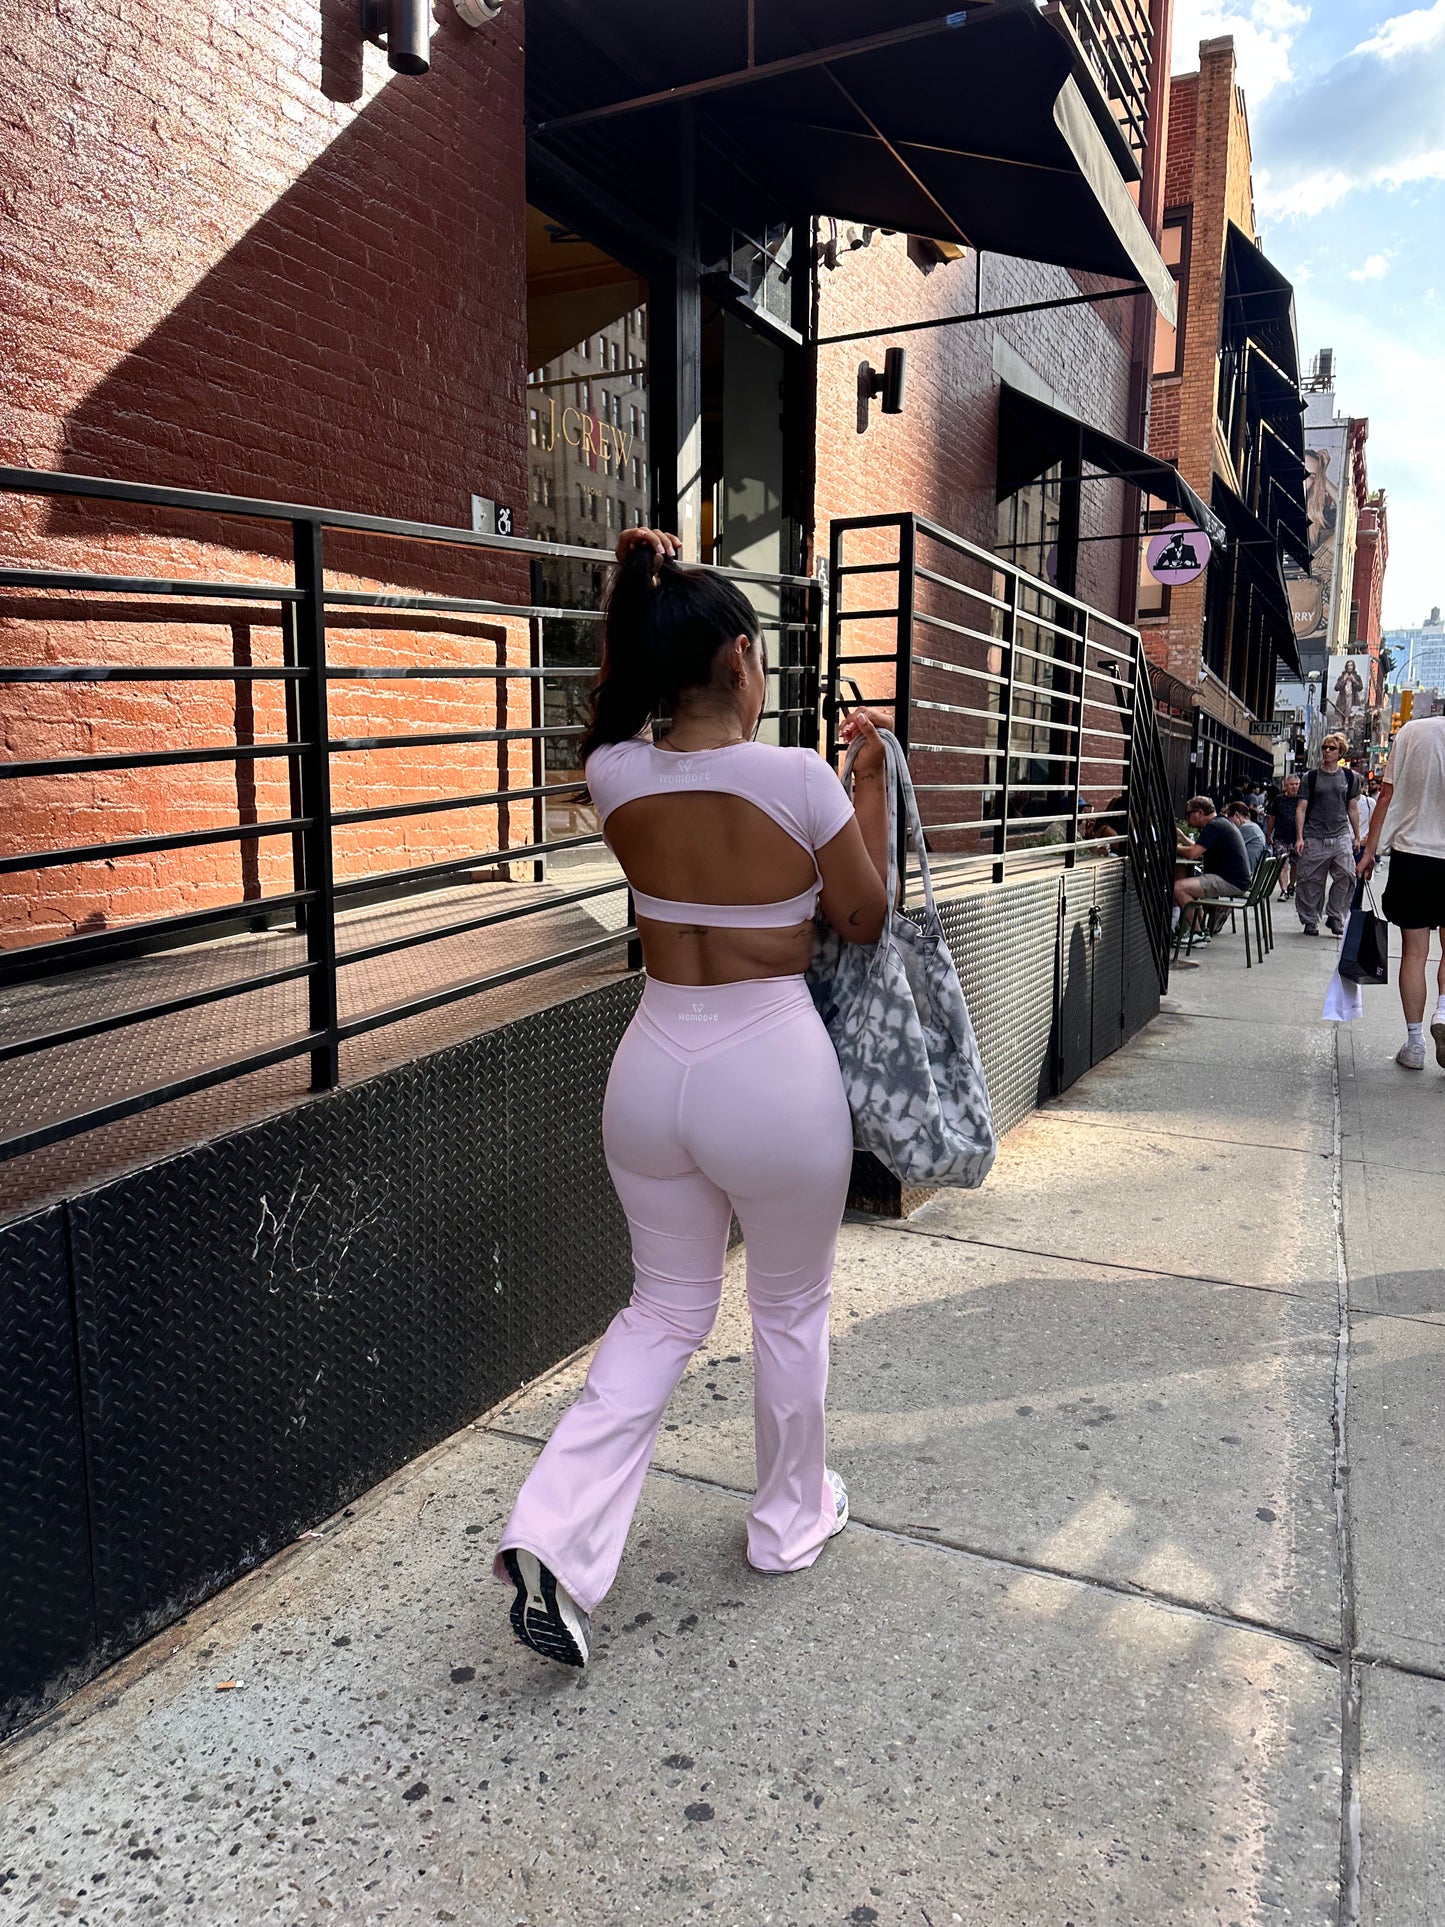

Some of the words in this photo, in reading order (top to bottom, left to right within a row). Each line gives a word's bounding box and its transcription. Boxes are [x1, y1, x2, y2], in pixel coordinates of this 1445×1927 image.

[547, 398, 634, 466] J.CREW
[1292, 611, 1316, 622] RRY
[1253, 723, 1279, 733] KITH
